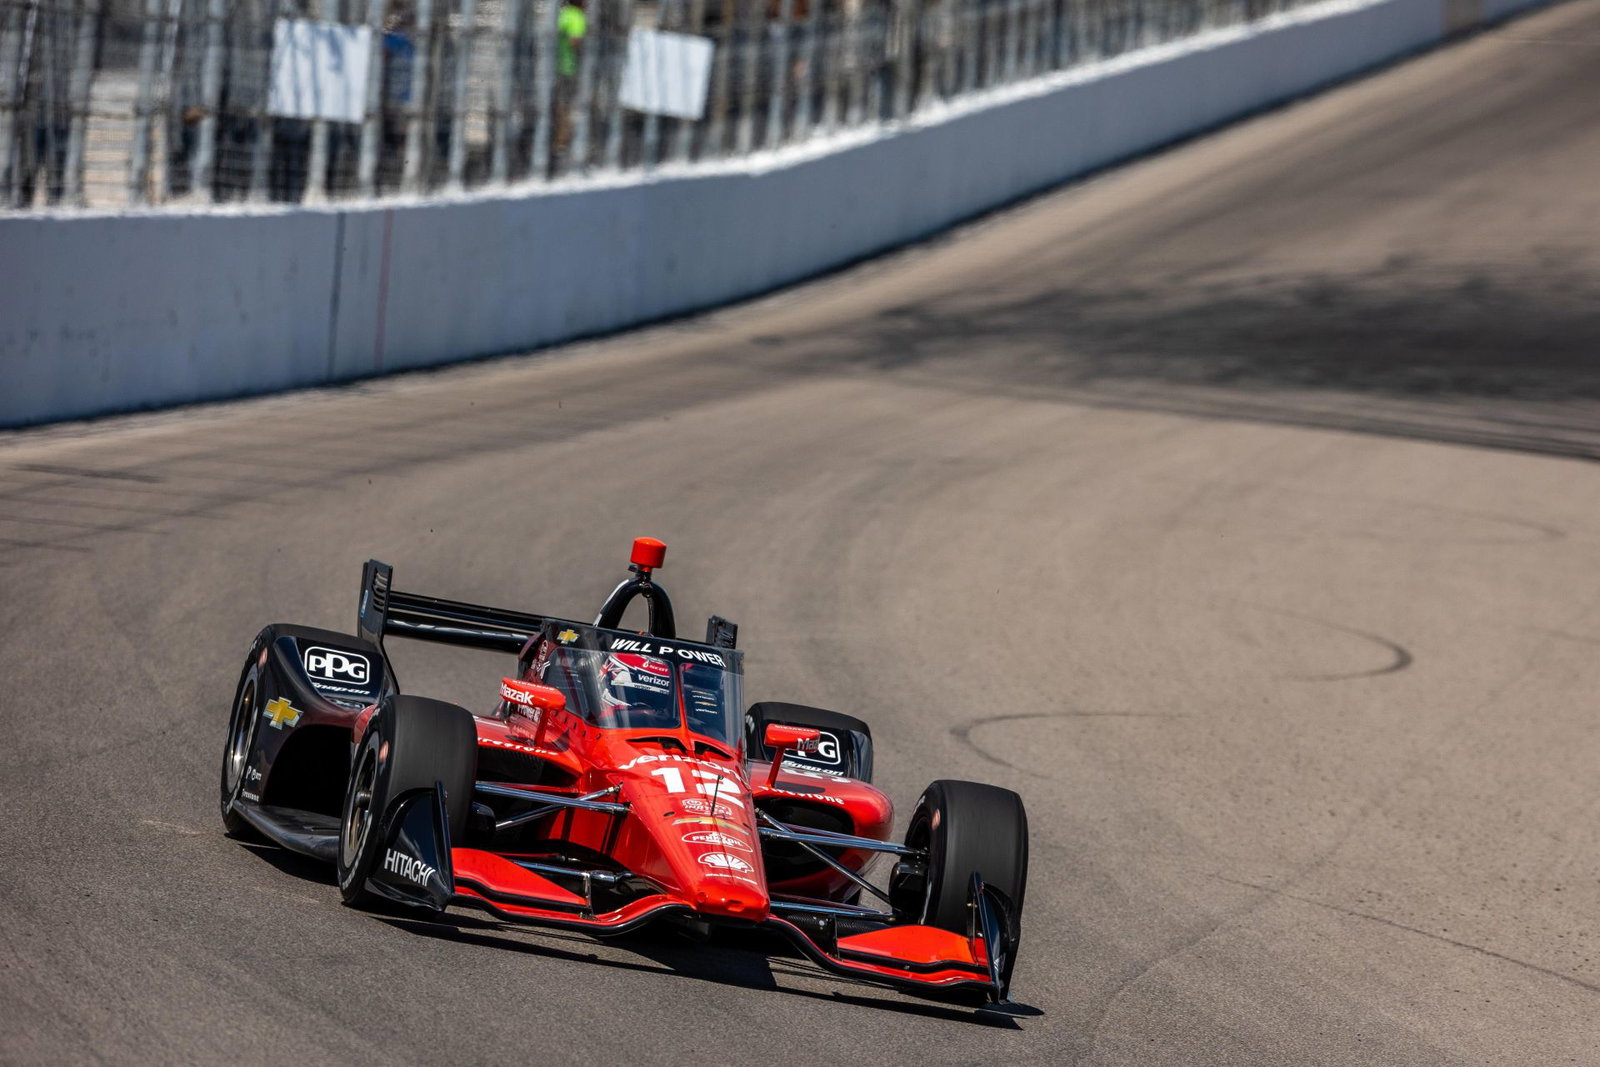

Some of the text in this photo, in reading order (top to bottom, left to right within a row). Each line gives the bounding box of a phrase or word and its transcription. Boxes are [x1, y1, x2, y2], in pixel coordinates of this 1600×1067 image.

[610, 638, 653, 653] WILL
[308, 653, 366, 679] PPG
[501, 683, 534, 706] Mazak
[477, 737, 559, 756] irestone
[618, 754, 742, 782] verizon
[650, 767, 745, 809] 12
[384, 848, 436, 887] HITACHI
